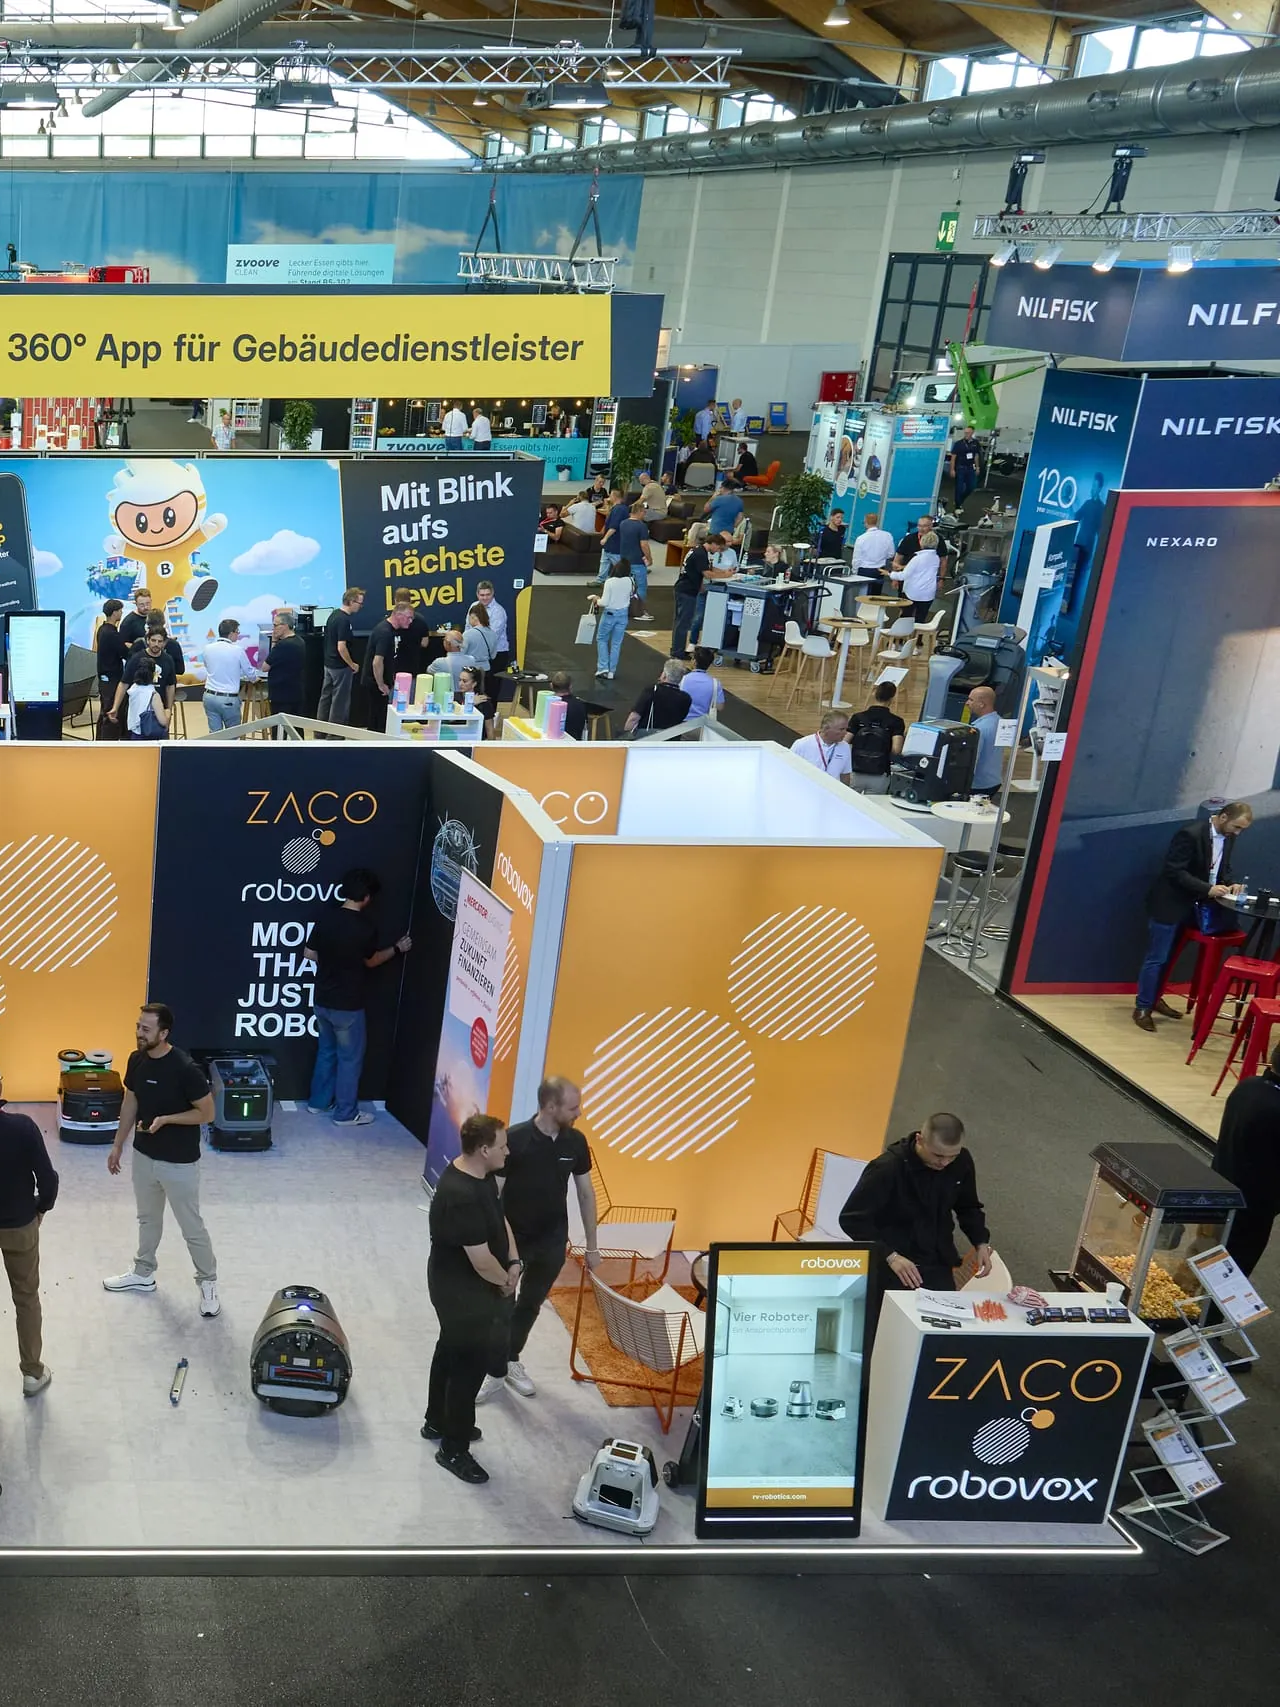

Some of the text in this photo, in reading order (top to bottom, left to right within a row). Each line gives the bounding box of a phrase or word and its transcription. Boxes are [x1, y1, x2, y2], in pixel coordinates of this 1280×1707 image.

[235, 259, 280, 267] zvoove
[314, 259, 334, 267] Essen
[323, 269, 348, 278] digitale
[1017, 296, 1098, 323] NILFISK
[1187, 303, 1280, 326] NILF
[8, 333, 88, 362] 360°
[96, 333, 161, 368] App
[174, 333, 220, 362] für
[233, 331, 584, 362] Gebäudedienstleister
[1051, 406, 1119, 432] NILFISK
[1161, 416, 1280, 436] NILFISK
[381, 472, 514, 512] Mit Blink
[1038, 467, 1077, 508] 120
[382, 514, 449, 545] aufs
[1146, 536, 1218, 548] NEXARO
[161, 563, 171, 576] B
[384, 543, 505, 578] nächste
[385, 577, 463, 611] Level
[246, 790, 378, 824] ZACO
[540, 790, 608, 825] CO
[241, 878, 347, 902] robovo
[497, 852, 534, 914] robovox
[252, 921, 315, 947] MO
[462, 921, 497, 960] GEMEINSAM
[253, 952, 318, 977] THA
[459, 937, 487, 970] ZUKUNFT
[457, 953, 495, 998] FINANZIEREN
[237, 982, 315, 1008] JUST
[800, 1257, 861, 1269] robovox
[733, 1312, 813, 1322] Vier Roboter.
[745, 1327, 808, 1335] Ansprechpartner
[927, 1357, 1122, 1402] ZACO
[752, 1493, 807, 1501] rv-robotics.com
[907, 1469, 1099, 1502] robovox
